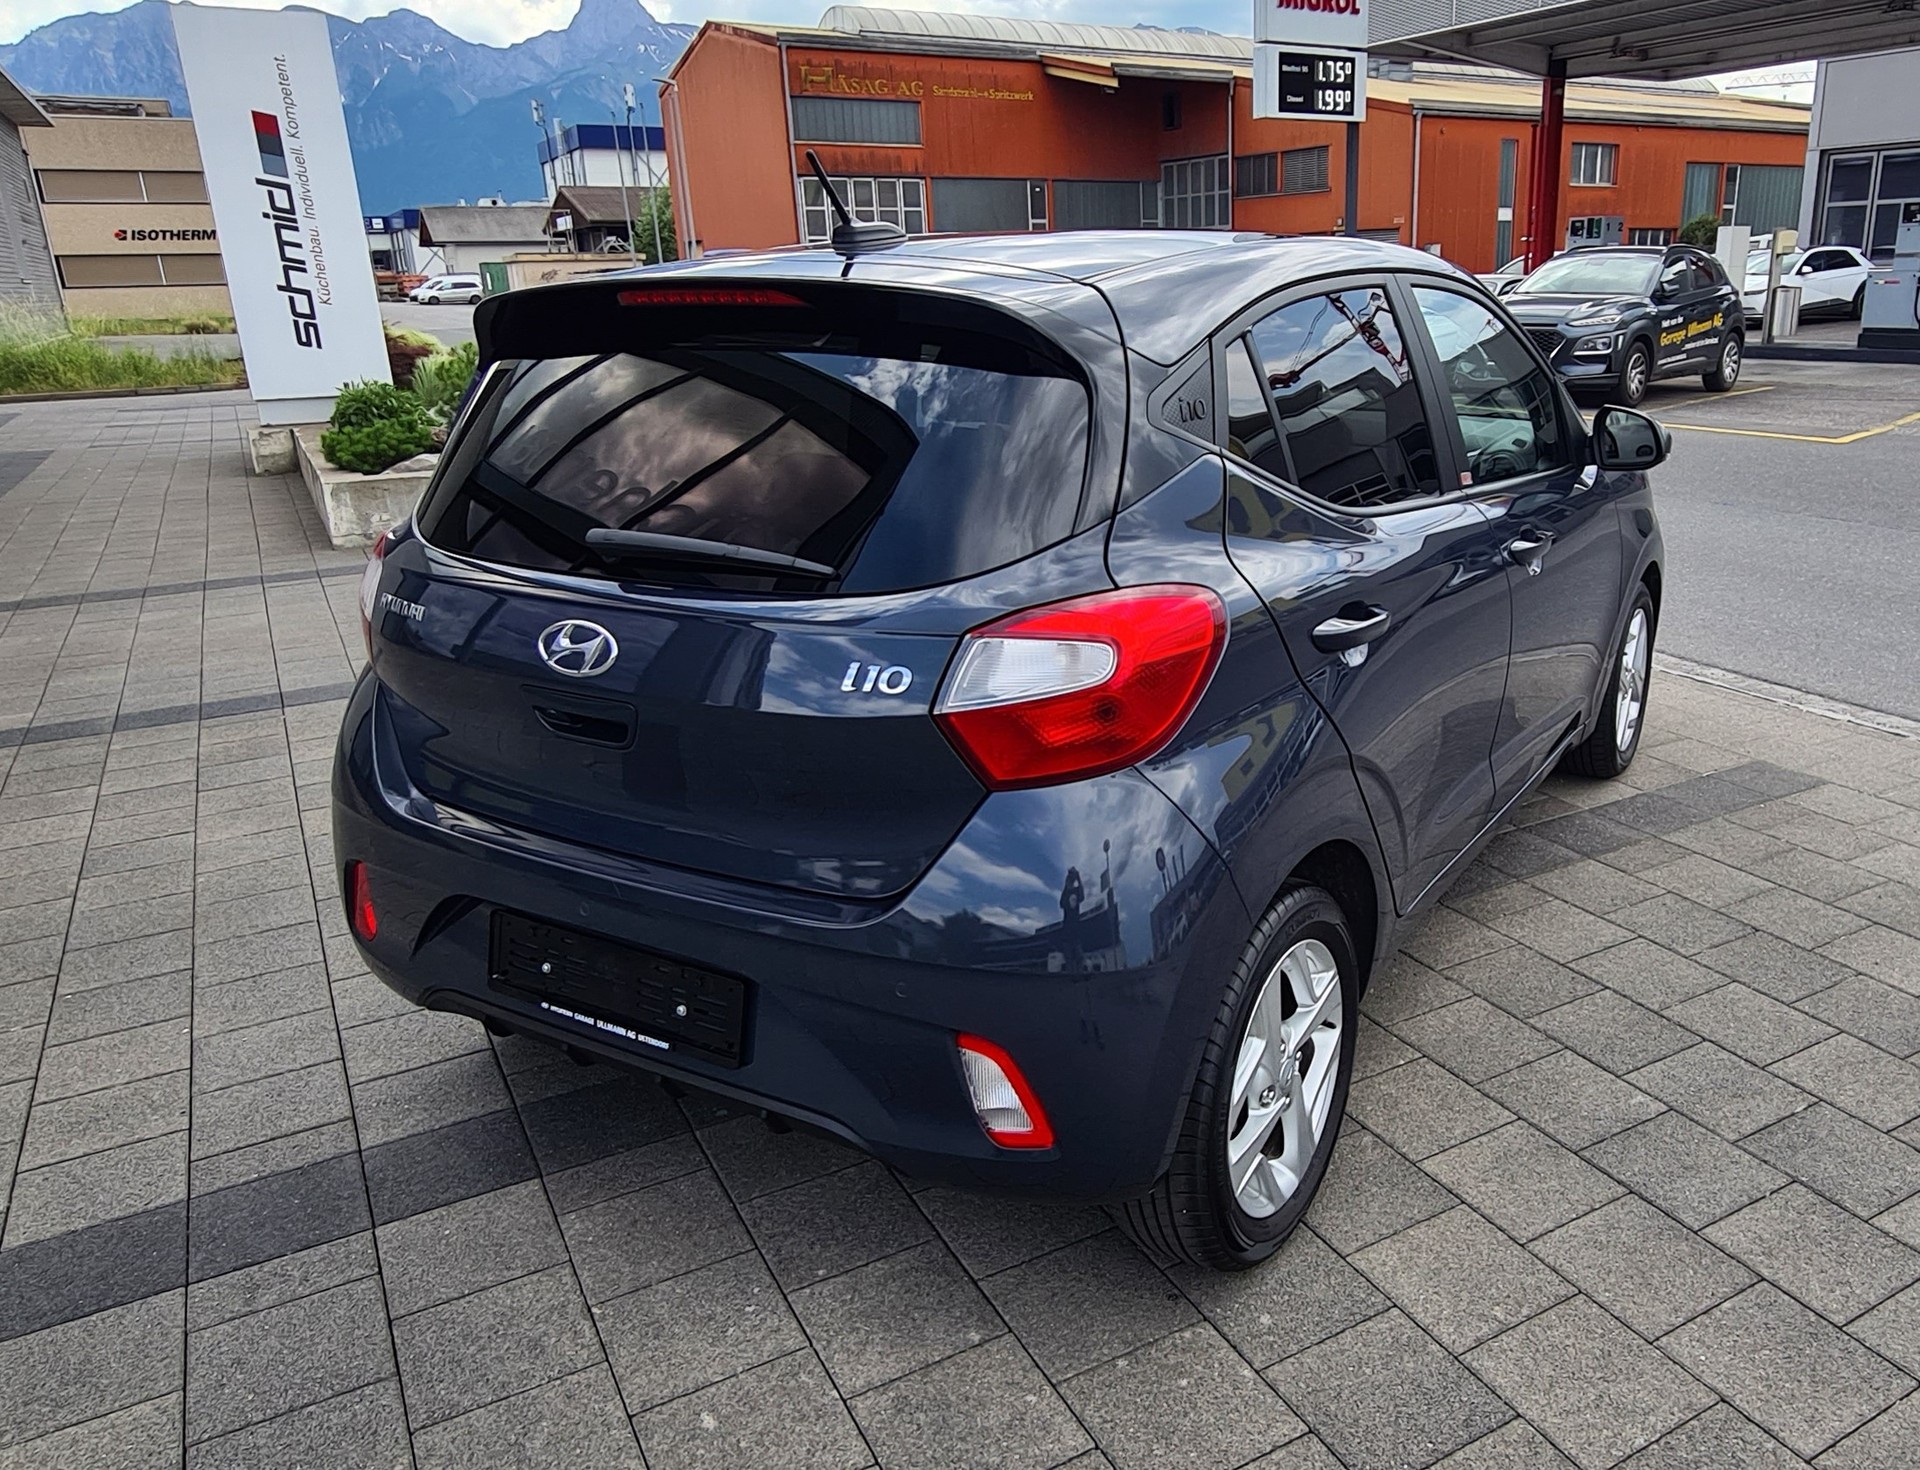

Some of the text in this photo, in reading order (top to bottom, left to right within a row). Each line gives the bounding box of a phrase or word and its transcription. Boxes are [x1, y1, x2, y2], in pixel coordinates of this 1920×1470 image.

[896, 80, 925, 96] AG
[273, 54, 333, 306] Küchenbau. Individuell. Kompetent.
[131, 229, 217, 241] ISOTHERM
[1617, 222, 1624, 232] 2
[255, 177, 323, 350] schmid
[1713, 313, 1723, 328] AG
[1178, 396, 1207, 423] i10
[840, 661, 914, 695] i10
[627, 1030, 636, 1039] AG
